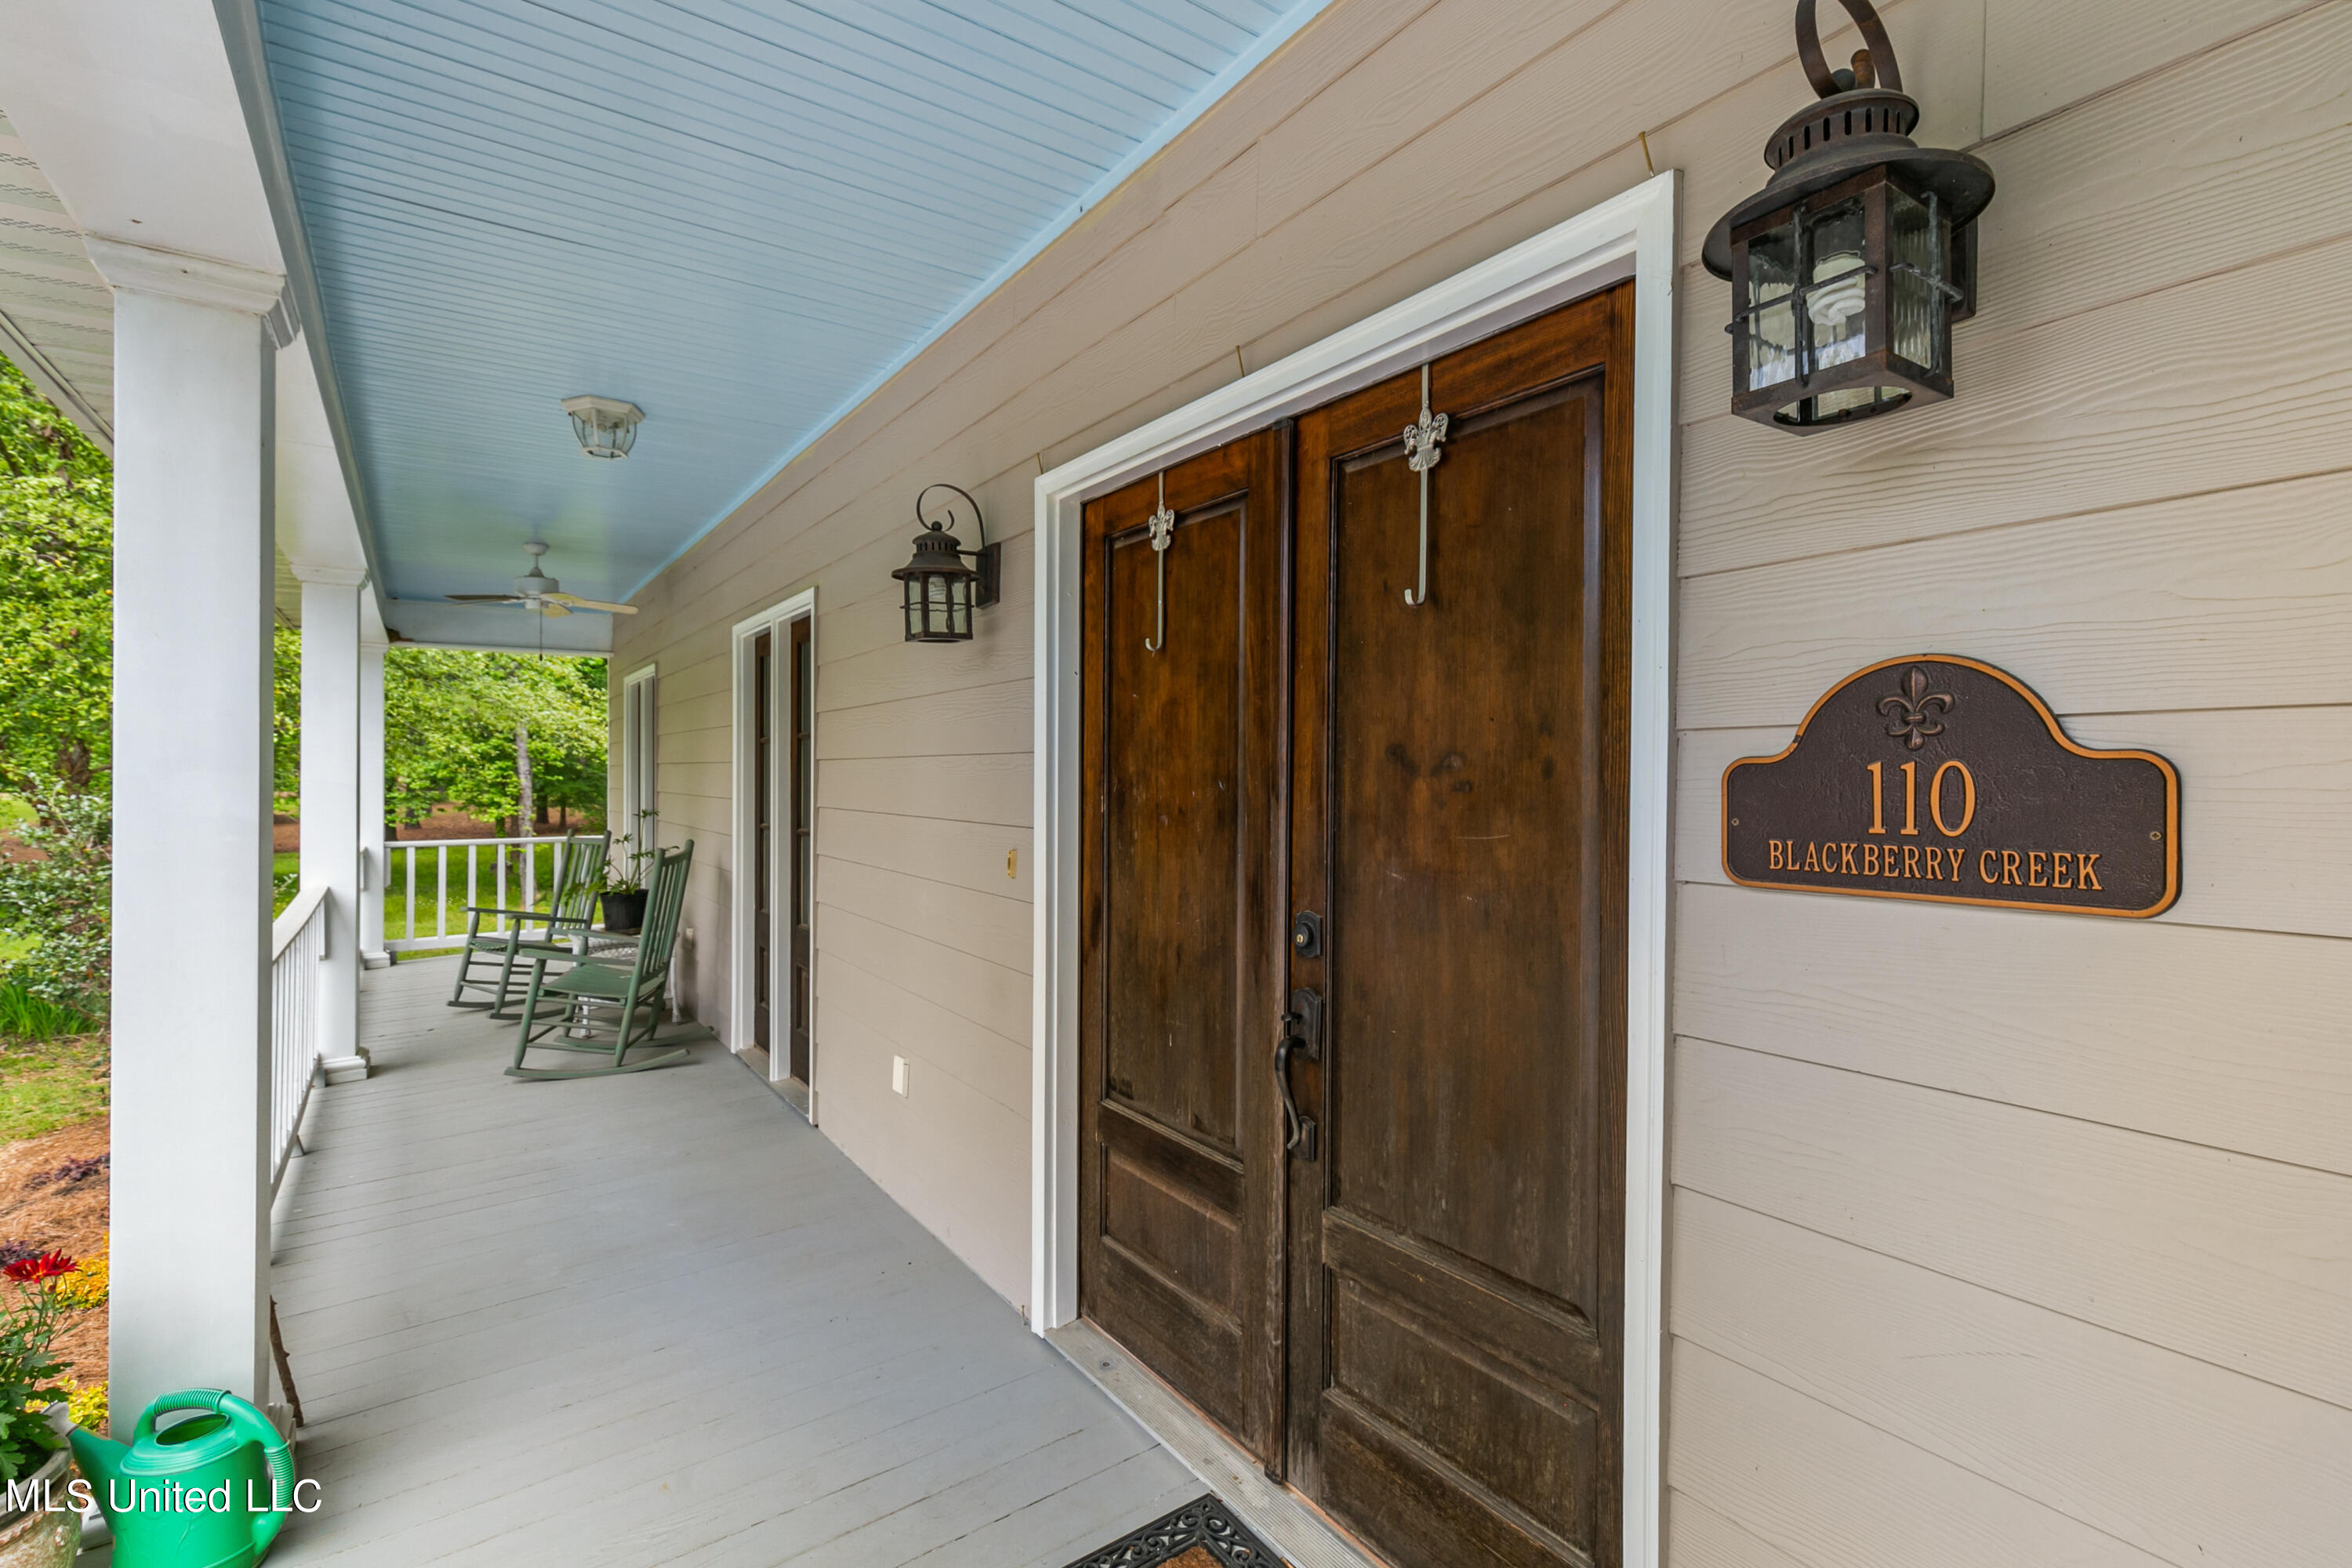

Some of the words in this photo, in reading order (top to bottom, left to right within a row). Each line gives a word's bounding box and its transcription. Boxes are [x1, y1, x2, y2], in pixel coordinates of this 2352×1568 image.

[1867, 760, 1976, 837] 110
[1769, 840, 1964, 881] BLACKBERRY
[1980, 850, 2103, 891] CREEK
